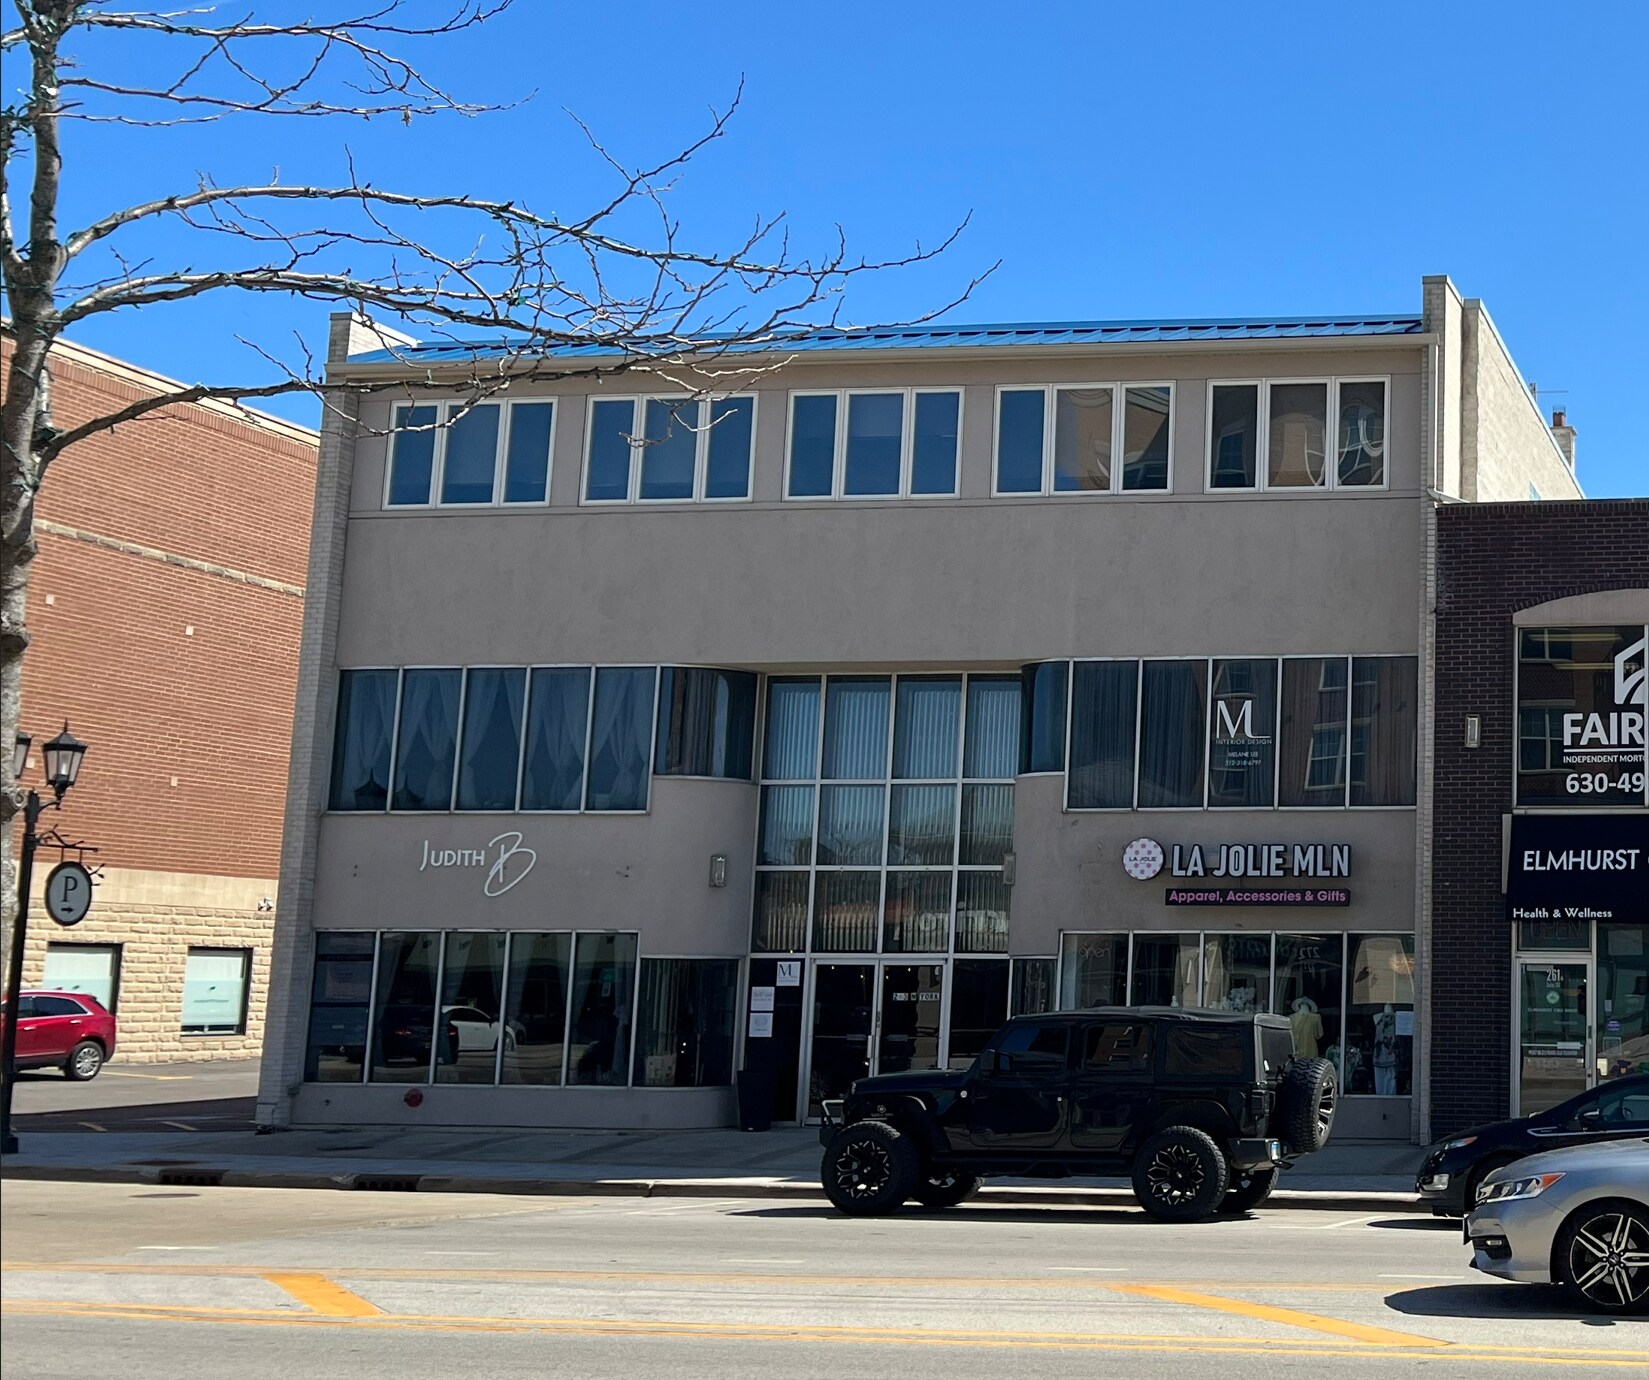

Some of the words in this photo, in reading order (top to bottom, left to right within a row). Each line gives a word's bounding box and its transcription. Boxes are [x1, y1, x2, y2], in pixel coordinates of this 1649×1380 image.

[1563, 712, 1645, 746] FAIR
[1563, 755, 1618, 764] INDEPENDENT
[484, 831, 537, 897] B
[1172, 845, 1205, 877] LA
[1212, 845, 1285, 877] JOLIE
[1293, 844, 1350, 877] MLN
[1523, 849, 1640, 871] ELMHURST
[61, 876, 77, 902] P
[1169, 890, 1223, 903] Apparel,
[1226, 890, 1301, 902] Accessories
[1304, 890, 1314, 902] &
[1317, 889, 1346, 902] Gifts
[1513, 907, 1549, 919] Health
[1552, 909, 1562, 918] &
[1564, 907, 1613, 918] Wellness
[919, 992, 939, 1001] YORK
